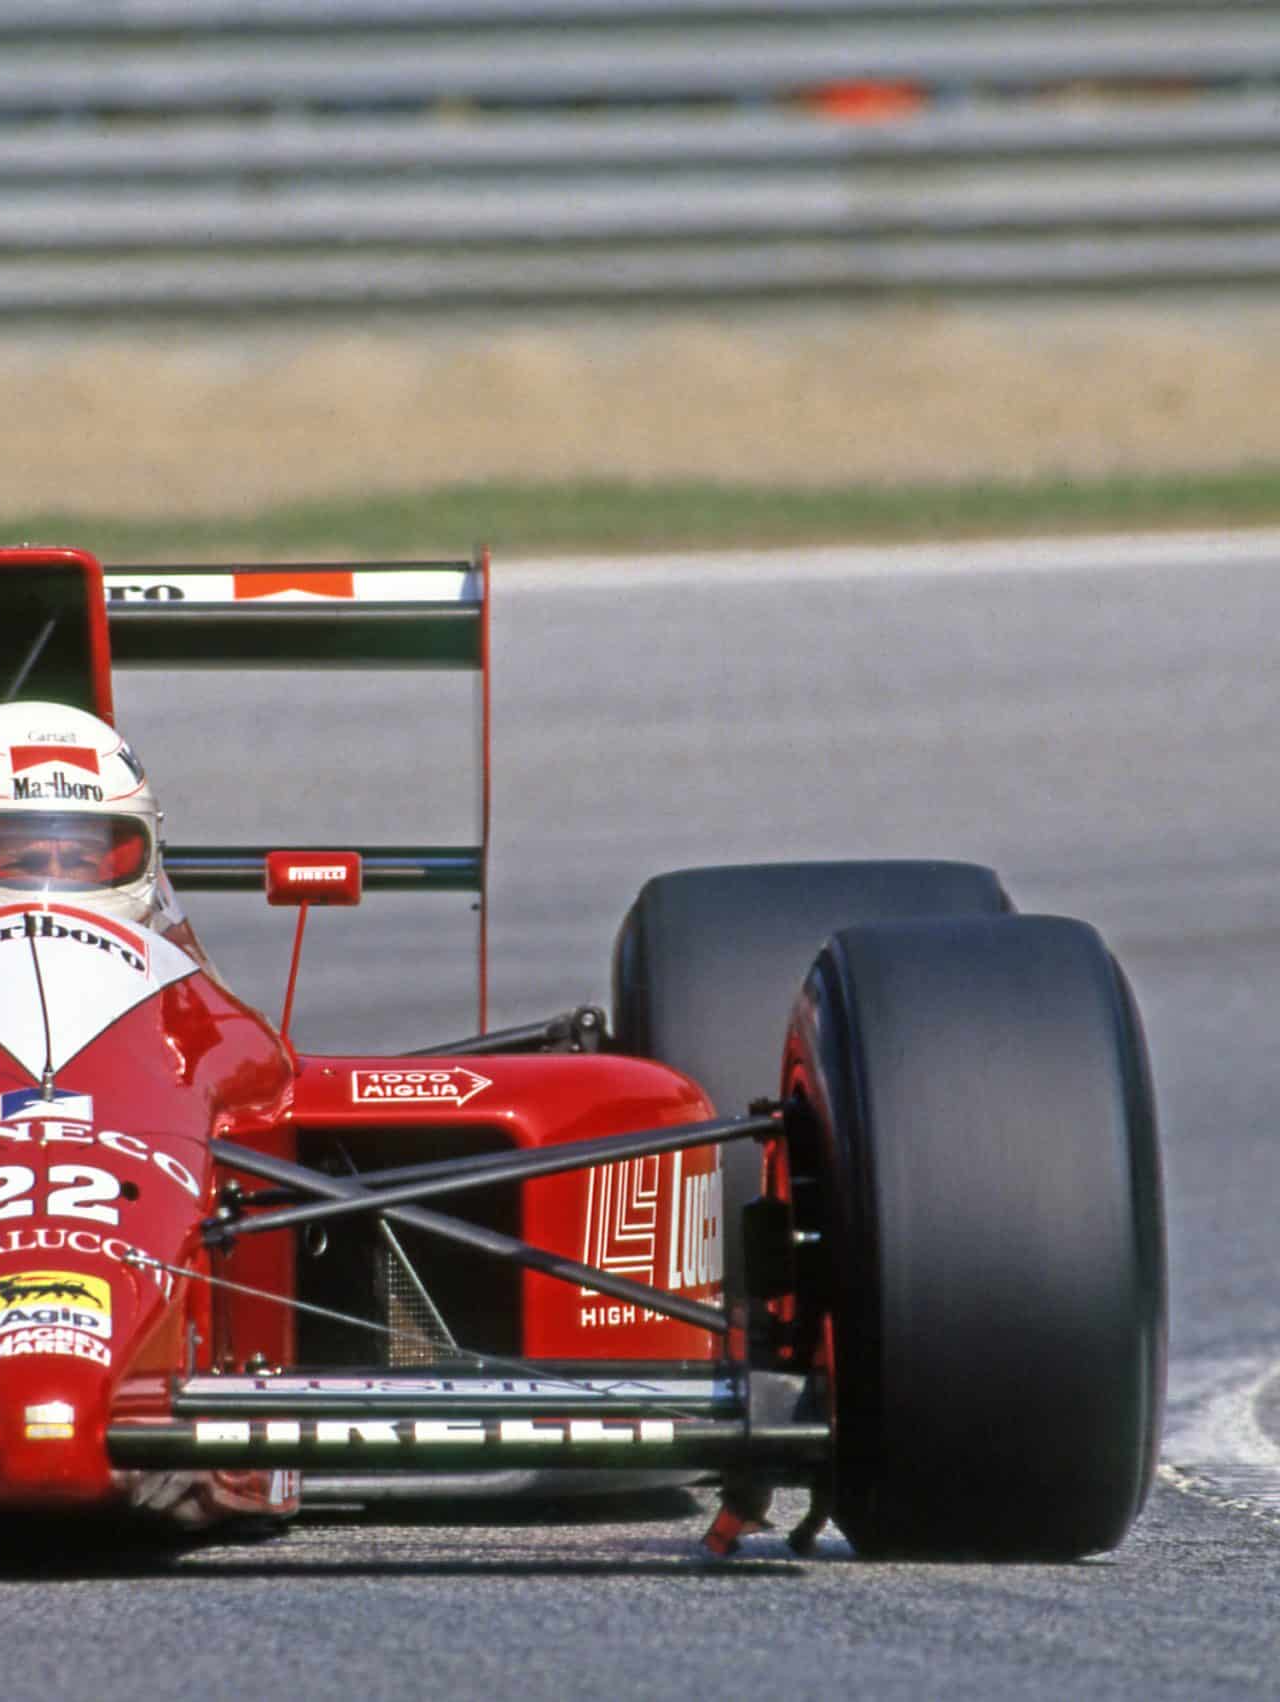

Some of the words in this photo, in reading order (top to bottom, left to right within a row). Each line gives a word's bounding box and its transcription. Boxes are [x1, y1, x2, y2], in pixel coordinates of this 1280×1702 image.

[13, 771, 104, 802] Marlboro
[288, 866, 346, 881] PIRELLI
[369, 1073, 451, 1083] 1000
[363, 1084, 458, 1097] MIGLIA
[0, 1307, 100, 1327] Agip
[581, 1306, 636, 1328] HIGH
